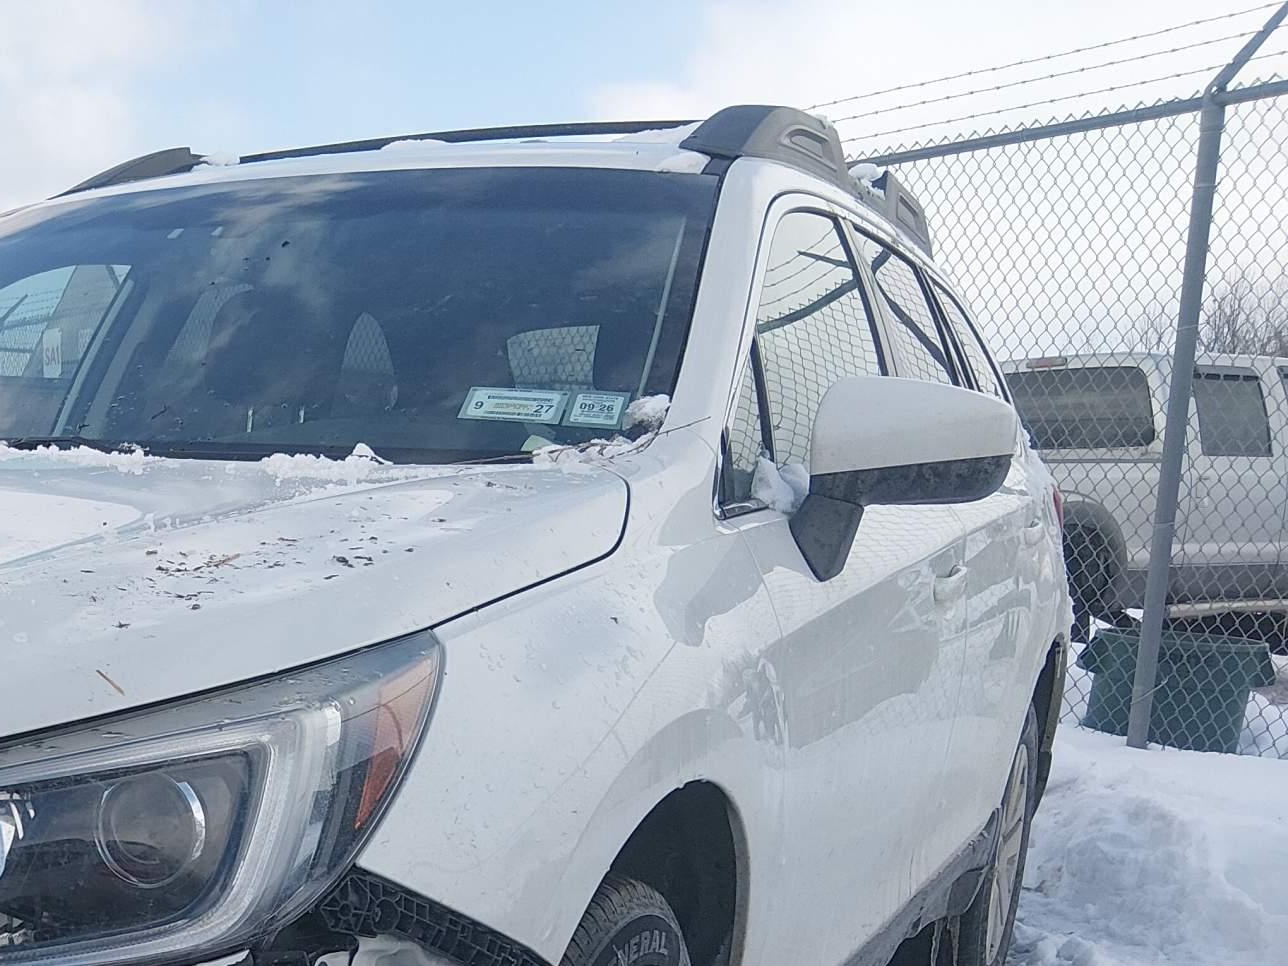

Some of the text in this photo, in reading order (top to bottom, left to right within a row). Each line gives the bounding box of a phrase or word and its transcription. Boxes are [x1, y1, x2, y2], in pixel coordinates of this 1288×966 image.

[473, 400, 484, 410] 9
[533, 404, 554, 414] 27
[579, 402, 614, 412] 09 26
